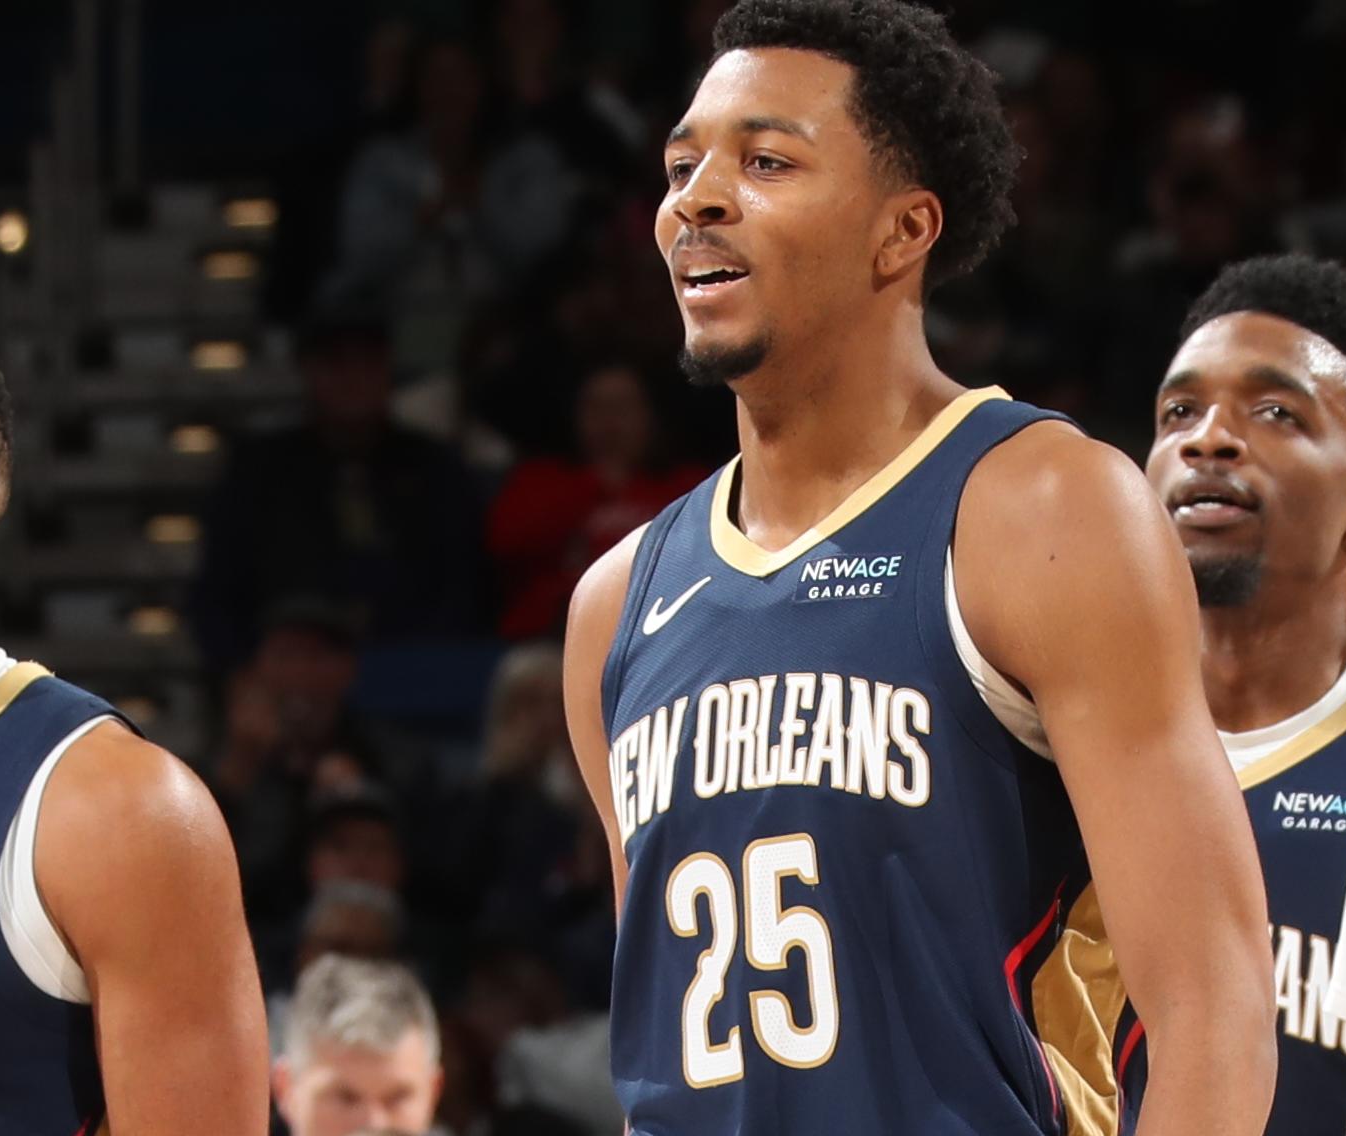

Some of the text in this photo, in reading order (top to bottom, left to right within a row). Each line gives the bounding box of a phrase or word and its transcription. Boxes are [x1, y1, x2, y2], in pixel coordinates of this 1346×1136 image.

[801, 555, 901, 583] NEWAGE
[808, 582, 882, 599] GARAGE
[693, 673, 931, 808] ORLEANS
[665, 832, 840, 1090] 25
